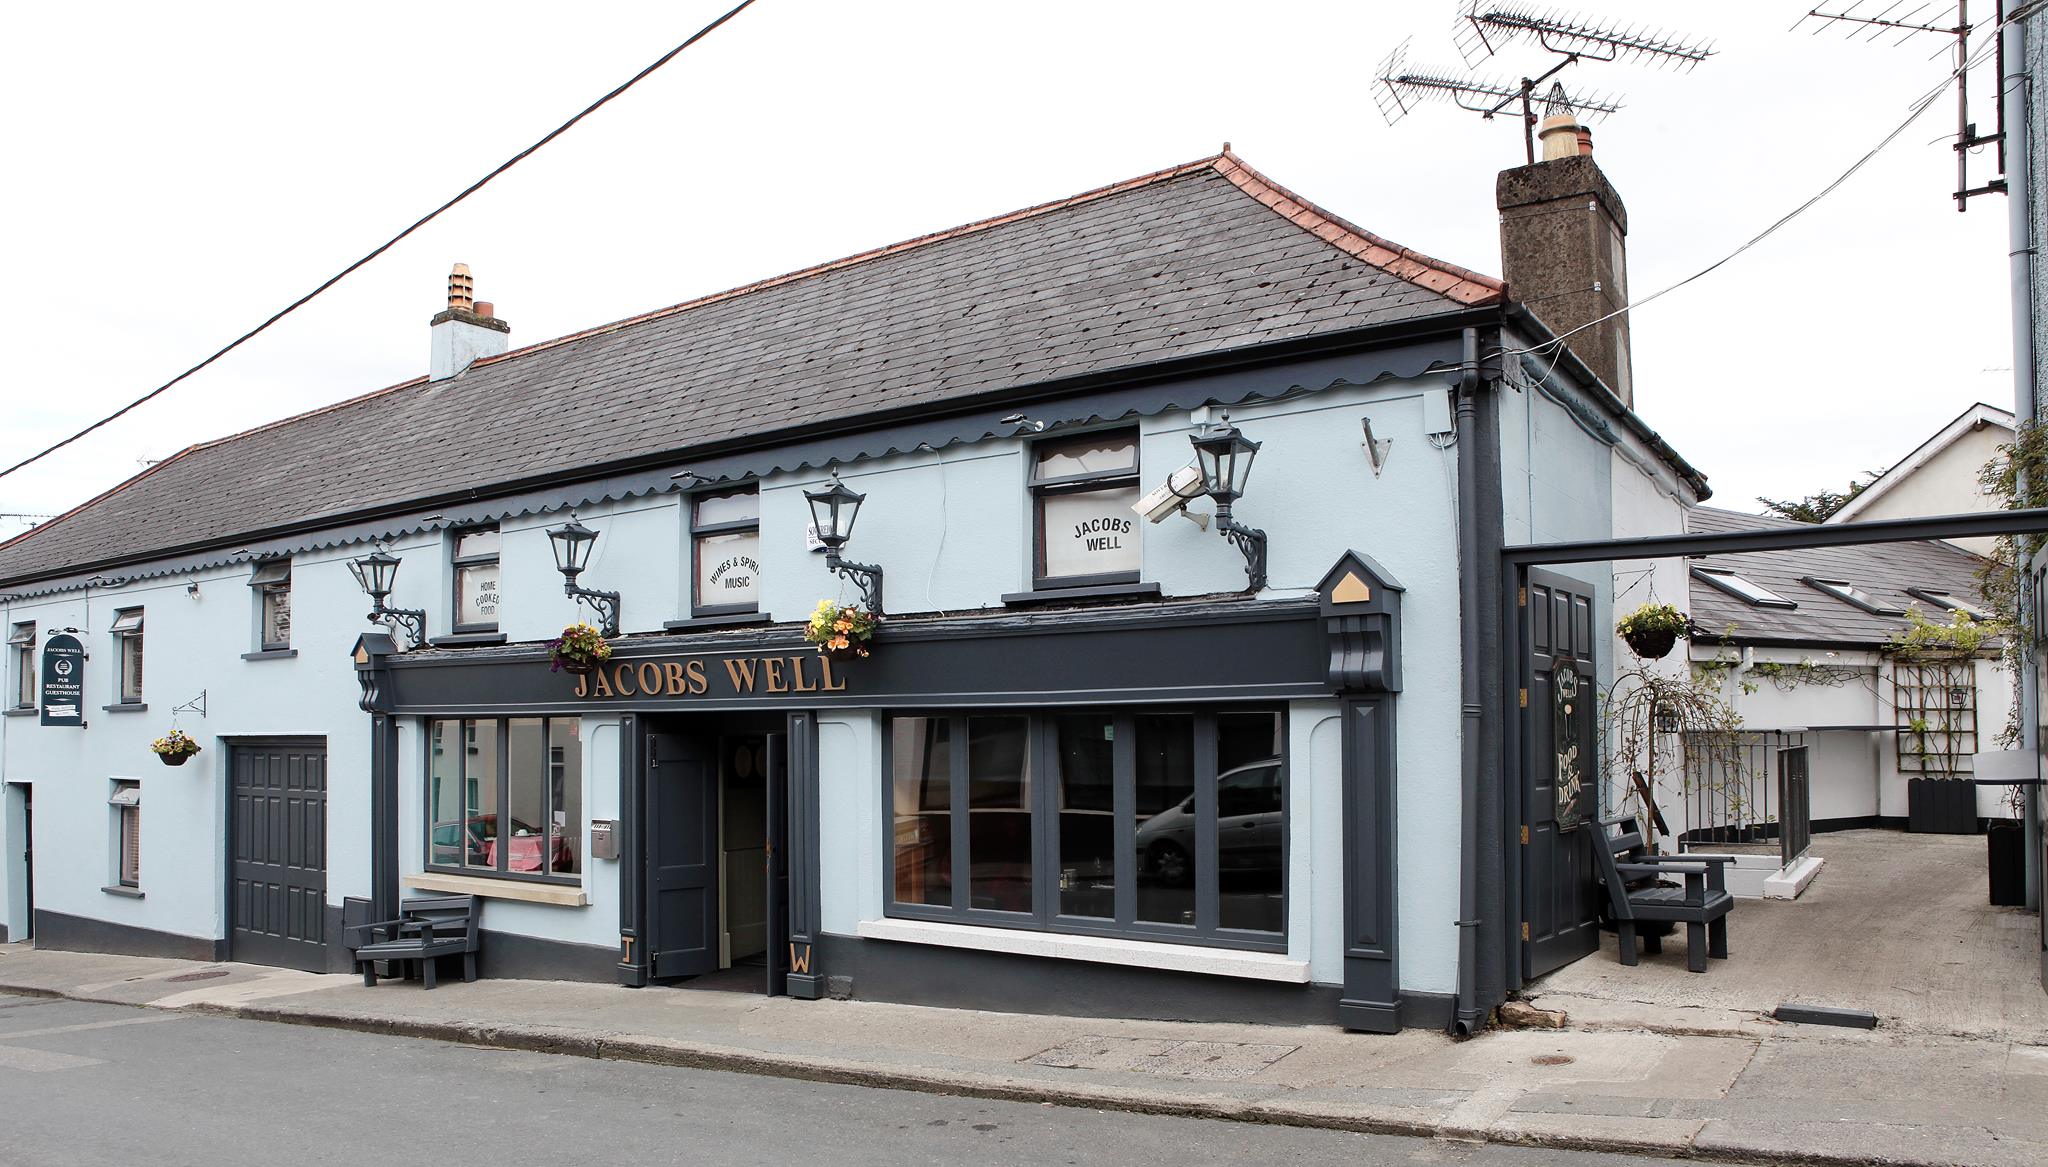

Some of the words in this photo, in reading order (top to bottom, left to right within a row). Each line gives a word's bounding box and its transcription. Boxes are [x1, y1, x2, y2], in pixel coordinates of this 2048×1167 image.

[1074, 517, 1132, 539] JACOBS
[1086, 536, 1122, 552] WELL
[709, 559, 731, 585] WINES
[733, 556, 739, 568] &
[725, 576, 750, 589] MUSIC
[480, 581, 496, 591] HOME
[480, 605, 496, 615] FOOD
[574, 660, 708, 698] JACOBS
[723, 655, 847, 694] WELL
[1557, 745, 1578, 782] FOOD
[1558, 770, 1581, 804] DRINK
[789, 942, 812, 974] W
